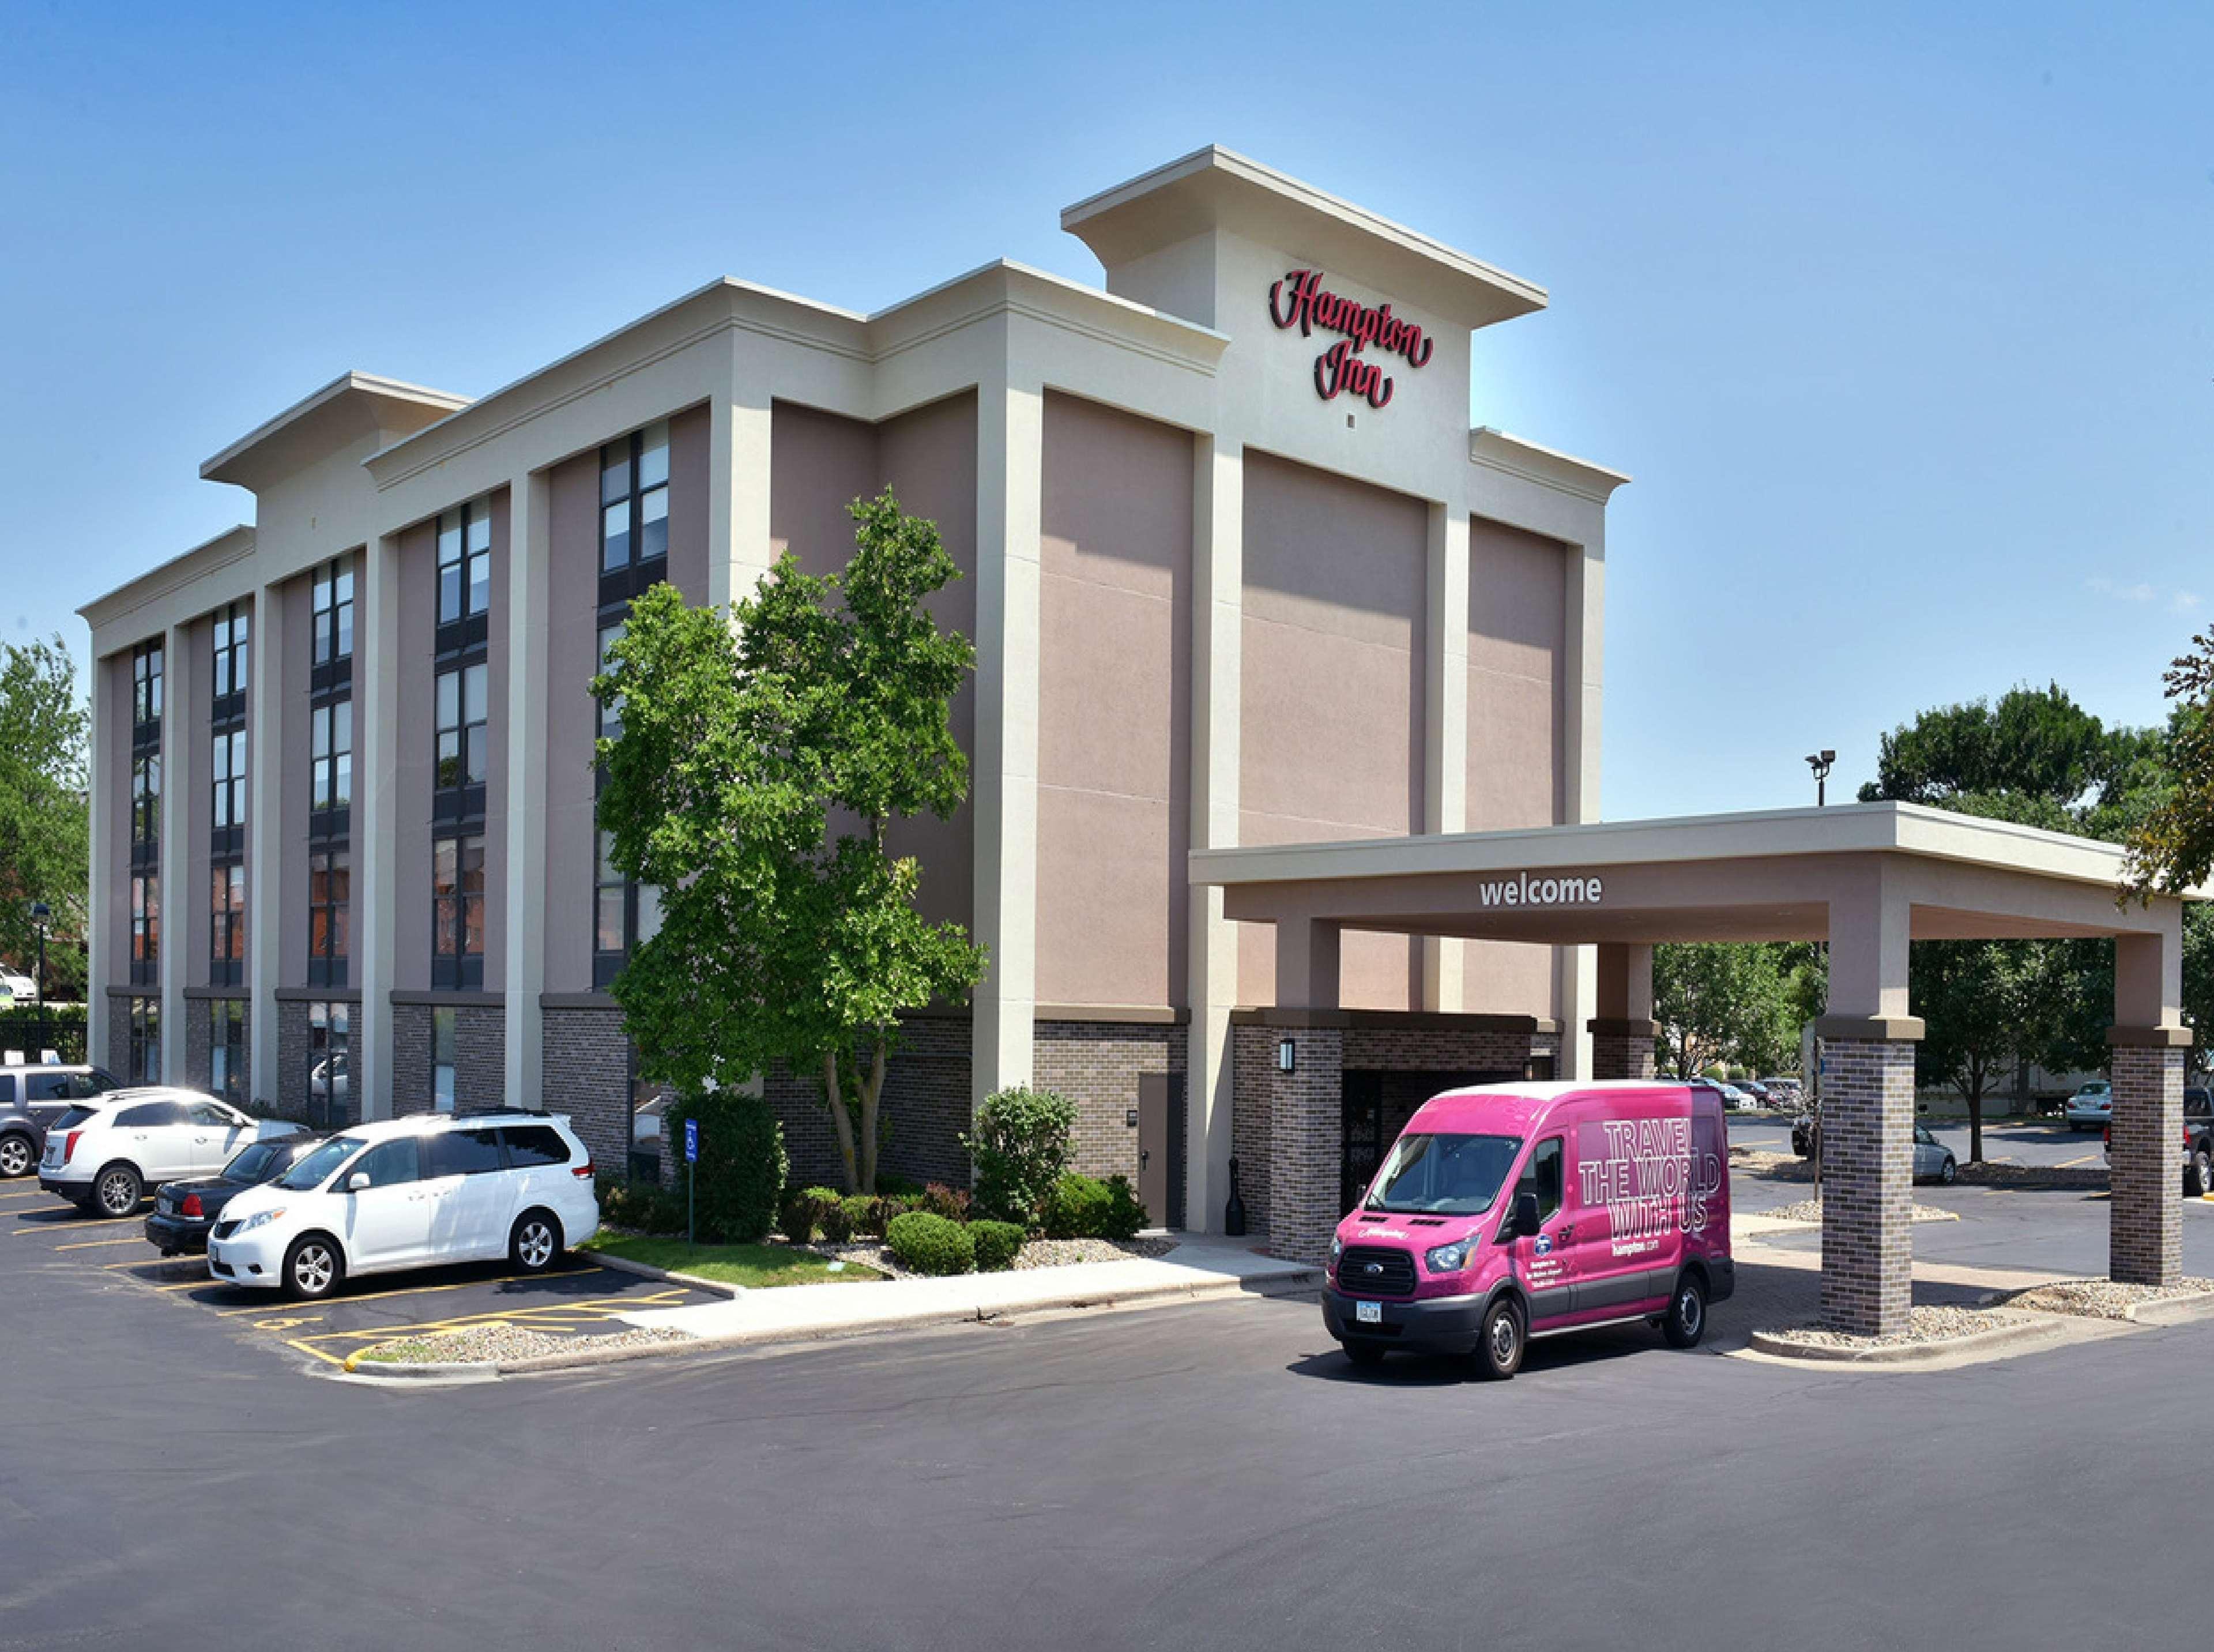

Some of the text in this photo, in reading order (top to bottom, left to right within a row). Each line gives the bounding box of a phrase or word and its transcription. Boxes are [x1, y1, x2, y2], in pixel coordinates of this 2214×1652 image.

[1269, 269, 1433, 368] Hampton
[1313, 340, 1395, 408] Inn
[1480, 871, 1602, 905] welcome
[1602, 1117, 1699, 1160] TRAVEL
[1578, 1153, 1720, 1205] THE WORLD
[1607, 1192, 1708, 1240] WITH US
